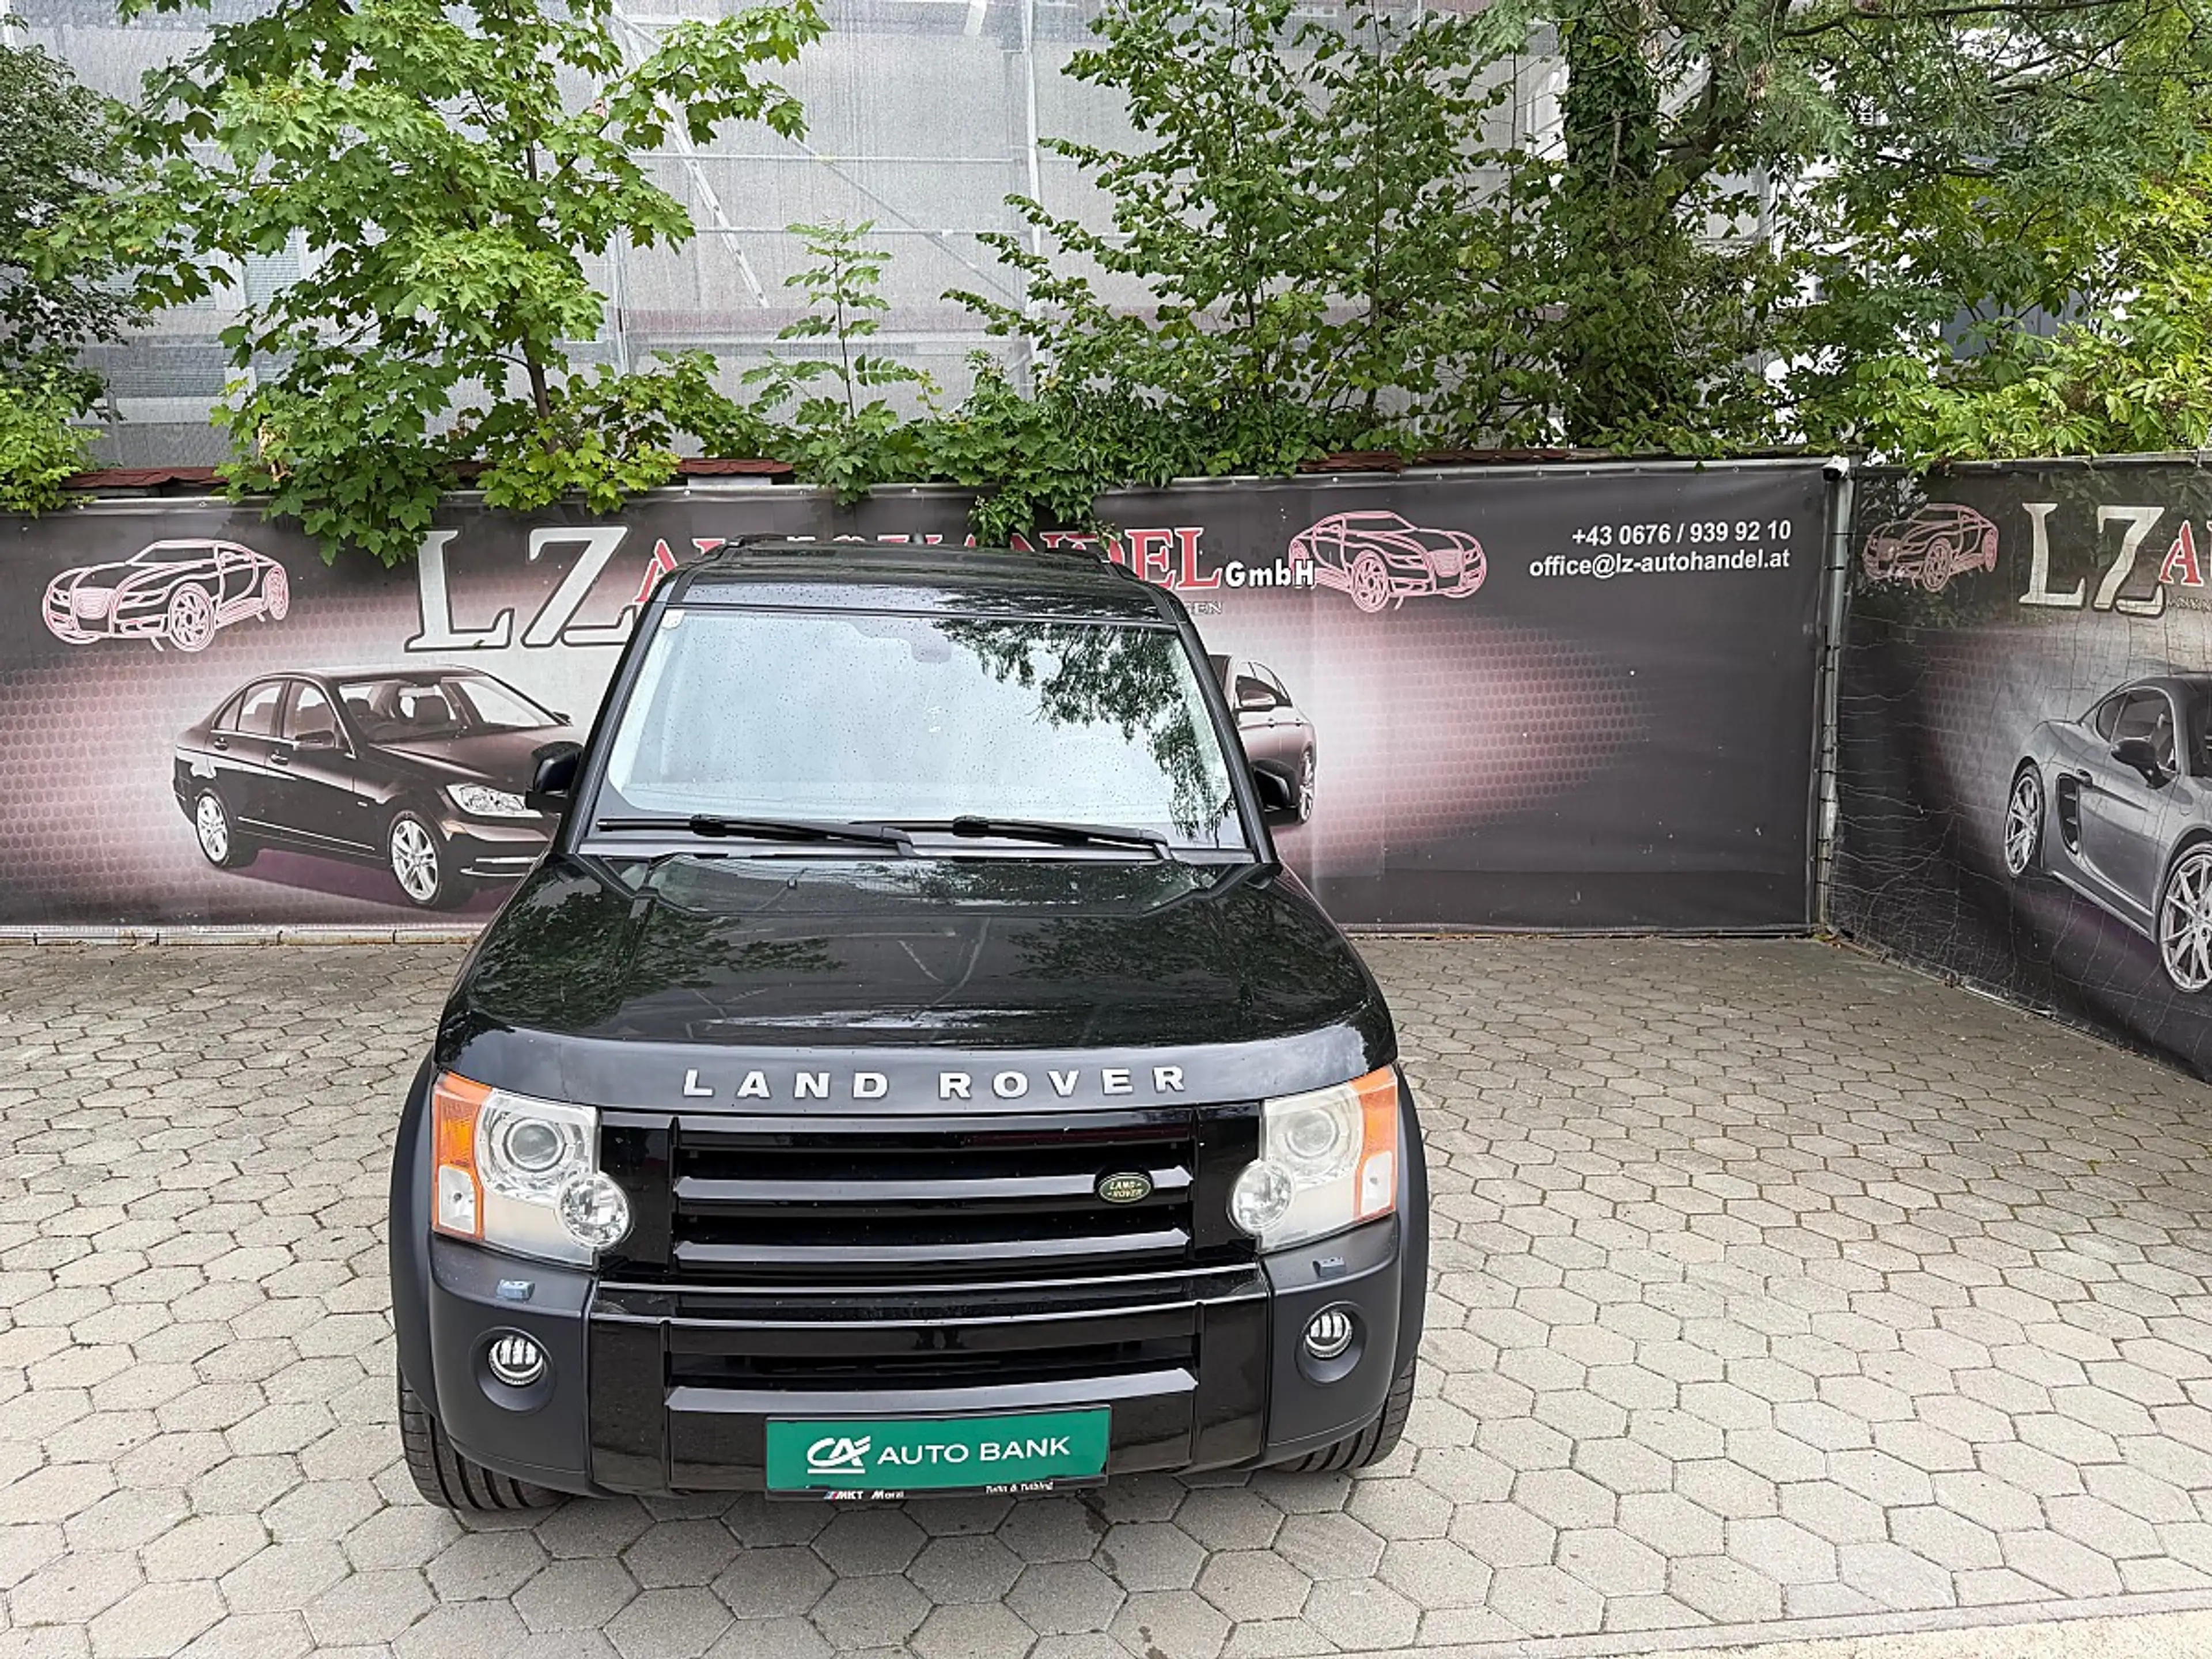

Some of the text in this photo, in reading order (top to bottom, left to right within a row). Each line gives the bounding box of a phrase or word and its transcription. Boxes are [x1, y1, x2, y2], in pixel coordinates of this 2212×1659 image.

[1572, 520, 1791, 546] +43 0676 / 939 92 10
[1529, 548, 1790, 579] office@lz-autohandel.at
[2018, 502, 2165, 617] LZ
[404, 525, 638, 652] LZ
[1224, 558, 1316, 589] GmbH
[683, 1065, 1185, 1099] LAND ROVER
[877, 1443, 969, 1465] AUTO
[979, 1436, 1070, 1461] BANK
